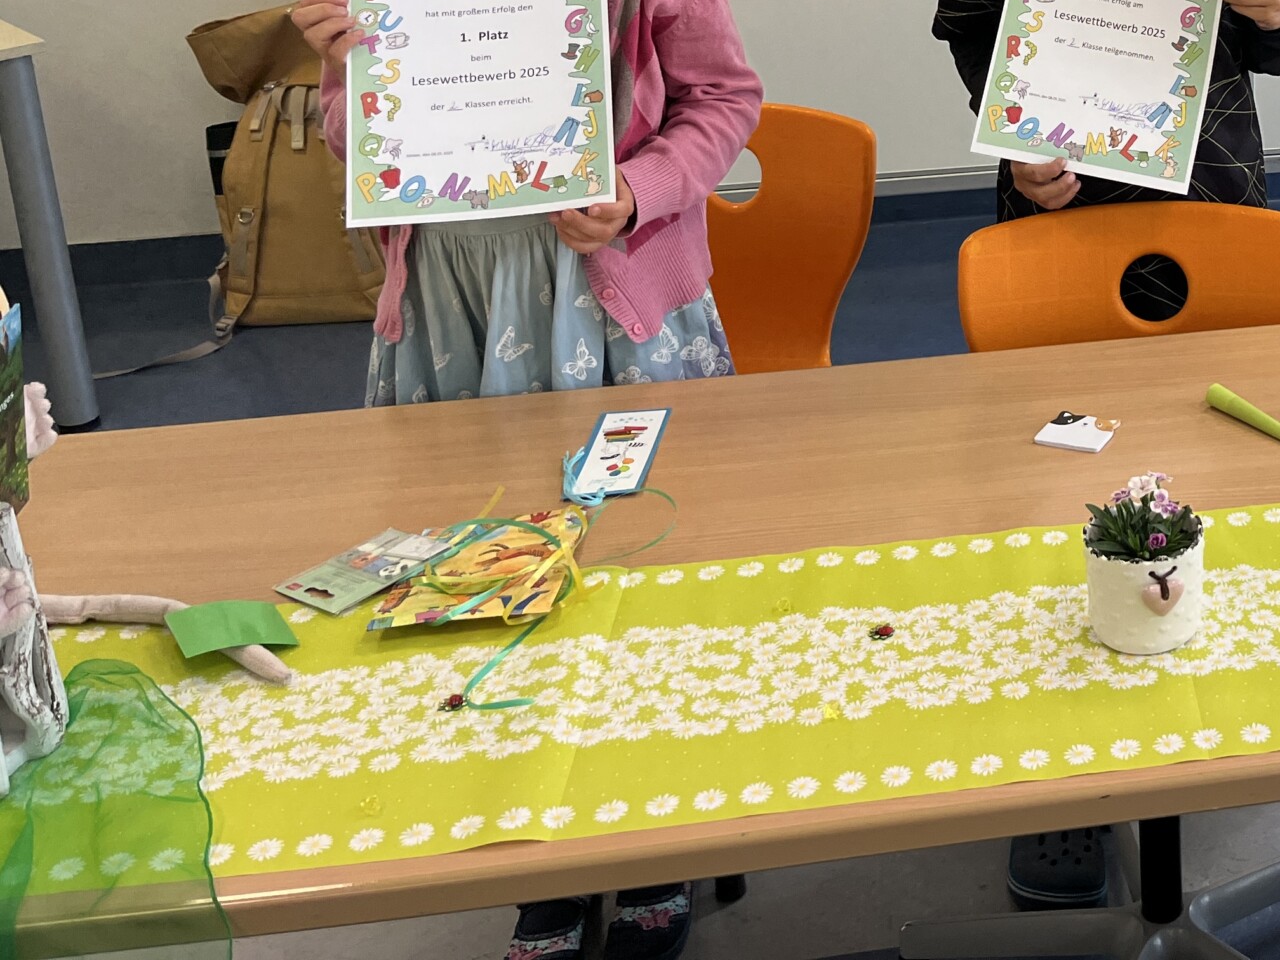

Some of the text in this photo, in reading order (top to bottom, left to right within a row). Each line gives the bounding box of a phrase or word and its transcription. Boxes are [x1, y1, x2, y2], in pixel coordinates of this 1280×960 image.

[378, 10, 402, 32] U
[458, 8, 490, 17] großem
[564, 8, 587, 34] G
[1025, 11, 1045, 33] S
[1054, 9, 1166, 39] Lesewettbewerb 2025
[1180, 7, 1201, 28] G
[359, 34, 381, 54] T
[460, 31, 509, 42] 1. Platz
[1006, 35, 1021, 59] R
[574, 45, 599, 73] H
[1082, 42, 1103, 51] Klasse
[1104, 46, 1155, 61] teilgenommen.
[1180, 42, 1204, 67] H
[380, 59, 400, 85] S
[412, 66, 550, 86] Lesewettbewerb 2025
[995, 72, 1018, 92] Q
[571, 83, 584, 106] I
[1169, 75, 1185, 95] I
[360, 92, 381, 119] R
[465, 101, 496, 109] Klassen
[498, 96, 533, 106] erreicht.
[582, 111, 599, 139] J
[987, 105, 1002, 131] P
[1172, 102, 1186, 128] J
[1016, 117, 1040, 140] O
[1046, 123, 1075, 148] N
[358, 134, 383, 158] Q
[1085, 132, 1108, 156] M
[1120, 133, 1138, 162] L
[1155, 136, 1181, 160] K
[571, 148, 599, 179] K
[356, 172, 376, 203] P
[438, 173, 471, 201] N
[488, 171, 518, 200] M
[530, 161, 550, 191] L
[399, 175, 426, 202] O
